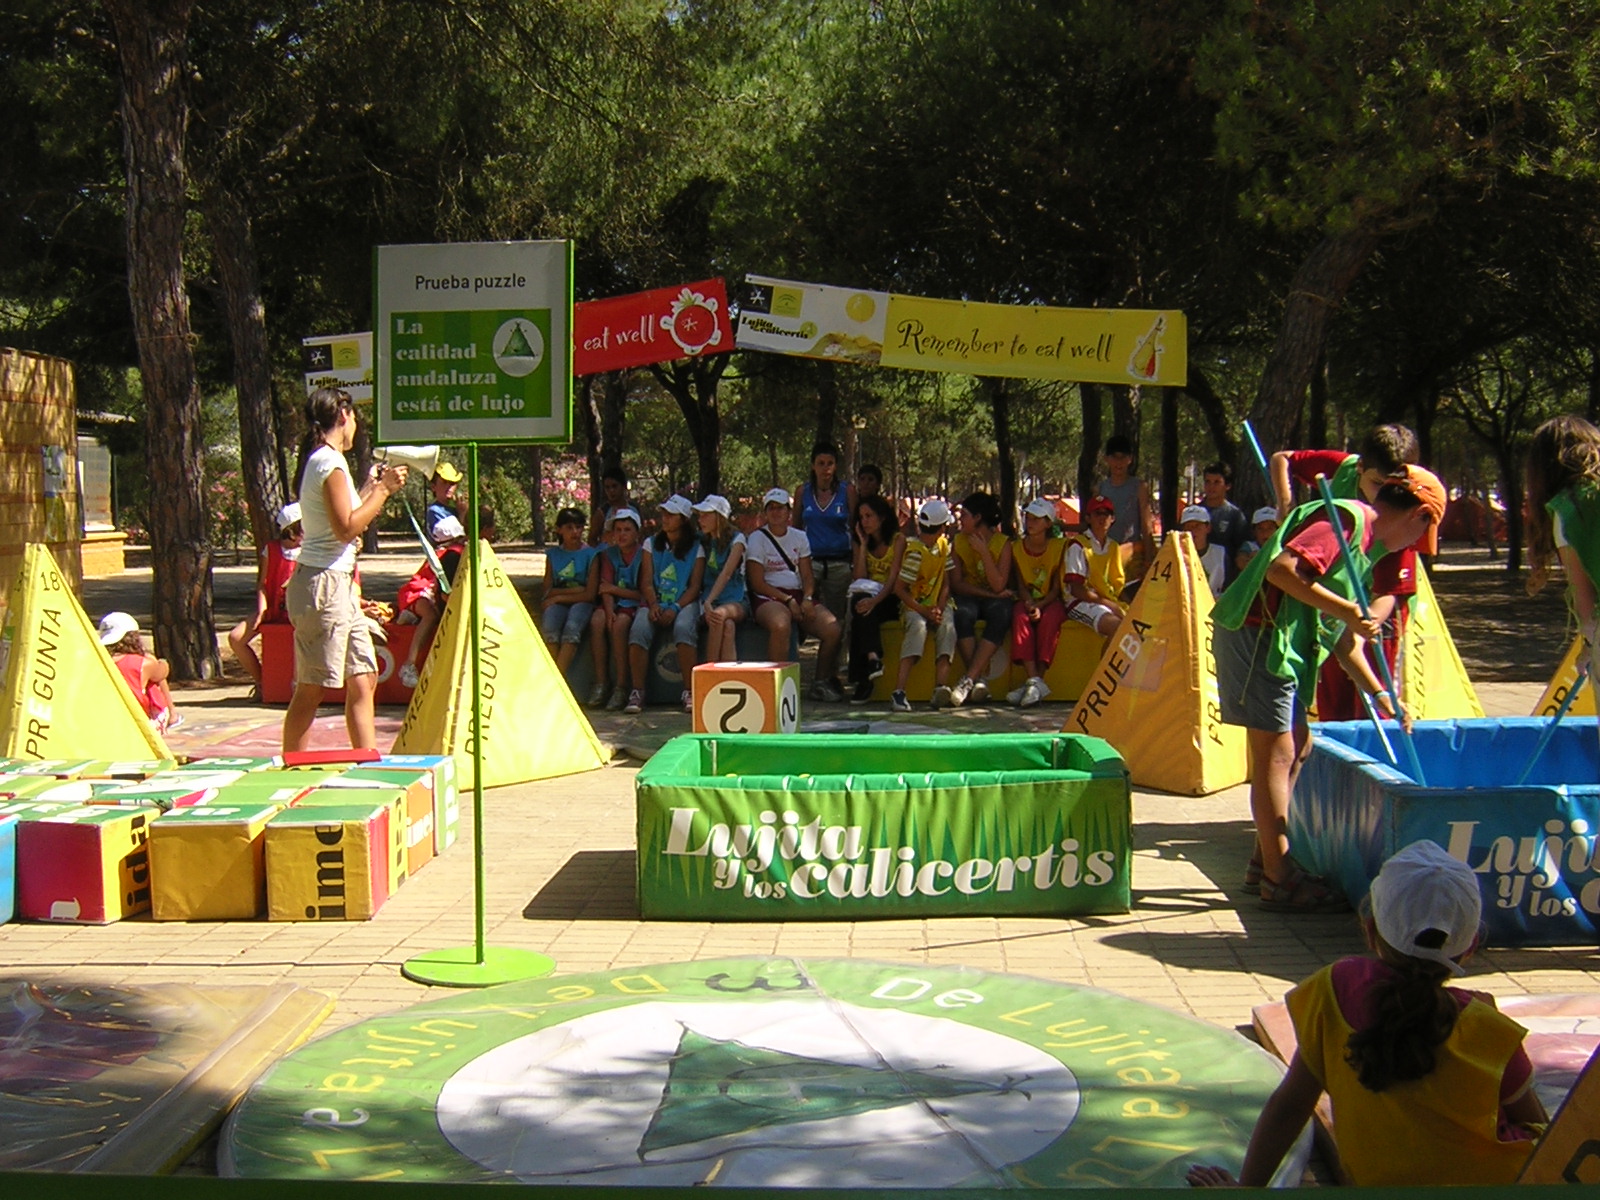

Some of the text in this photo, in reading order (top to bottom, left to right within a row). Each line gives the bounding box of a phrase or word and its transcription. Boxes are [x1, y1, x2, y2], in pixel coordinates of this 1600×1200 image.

[416, 273, 526, 292] Prueba puzzle
[396, 319, 423, 335] La
[584, 313, 655, 351] eat well
[896, 319, 1115, 362] Remember to eat well
[396, 343, 477, 361] calidad
[396, 370, 497, 387] andaluza
[396, 394, 525, 415] está de lujo
[41, 570, 61, 591] 18
[483, 568, 503, 588] 16
[1150, 560, 1173, 583] 14
[25, 608, 62, 759] PREGUNTA
[1077, 617, 1152, 733] PRUEBA
[662, 807, 866, 872] Lujita
[713, 838, 1116, 900] y los calicertis
[1496, 874, 1526, 908] y
[1529, 890, 1577, 917] los
[871, 977, 985, 1009] De
